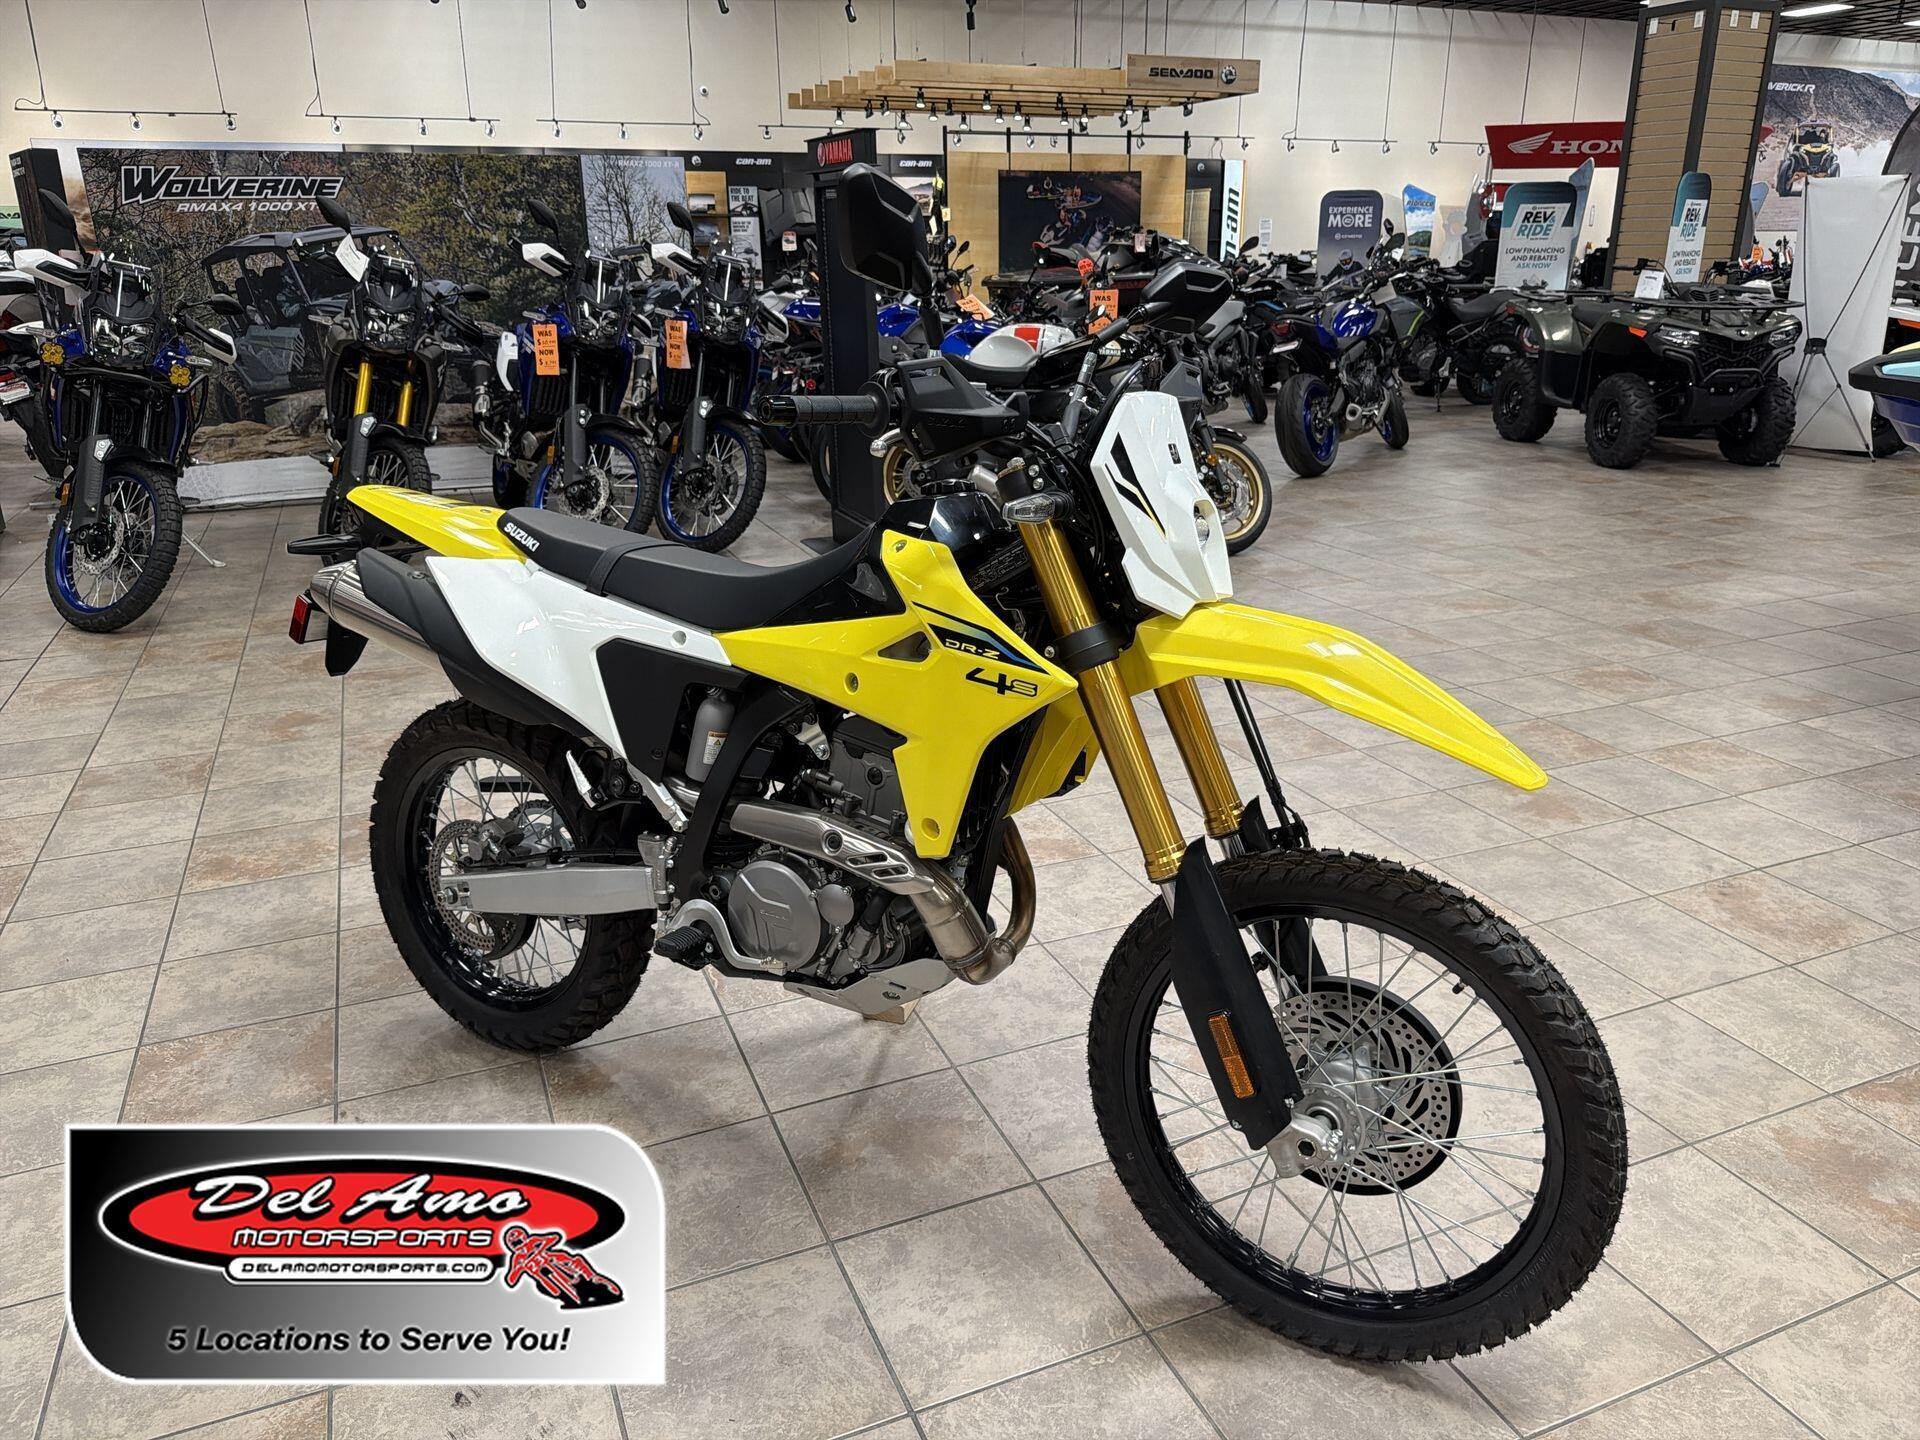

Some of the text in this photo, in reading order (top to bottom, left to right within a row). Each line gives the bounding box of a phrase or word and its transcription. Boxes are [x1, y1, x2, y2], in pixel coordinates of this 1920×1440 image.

[824, 138, 853, 164] YAMAHA
[735, 158, 772, 166] can-am
[899, 160, 933, 168] can-am
[121, 165, 345, 204] WOLVERINE
[176, 202, 243, 213] RMAX4
[250, 201, 294, 212] 1000
[1328, 206, 1374, 214] EXPERIENCE
[1327, 214, 1373, 228] MORE
[1522, 211, 1556, 224] REV
[1516, 223, 1554, 239] RIDE
[1680, 223, 1698, 238] RIDE
[504, 522, 540, 552] SUZUKI
[945, 638, 1000, 660] DR-Z
